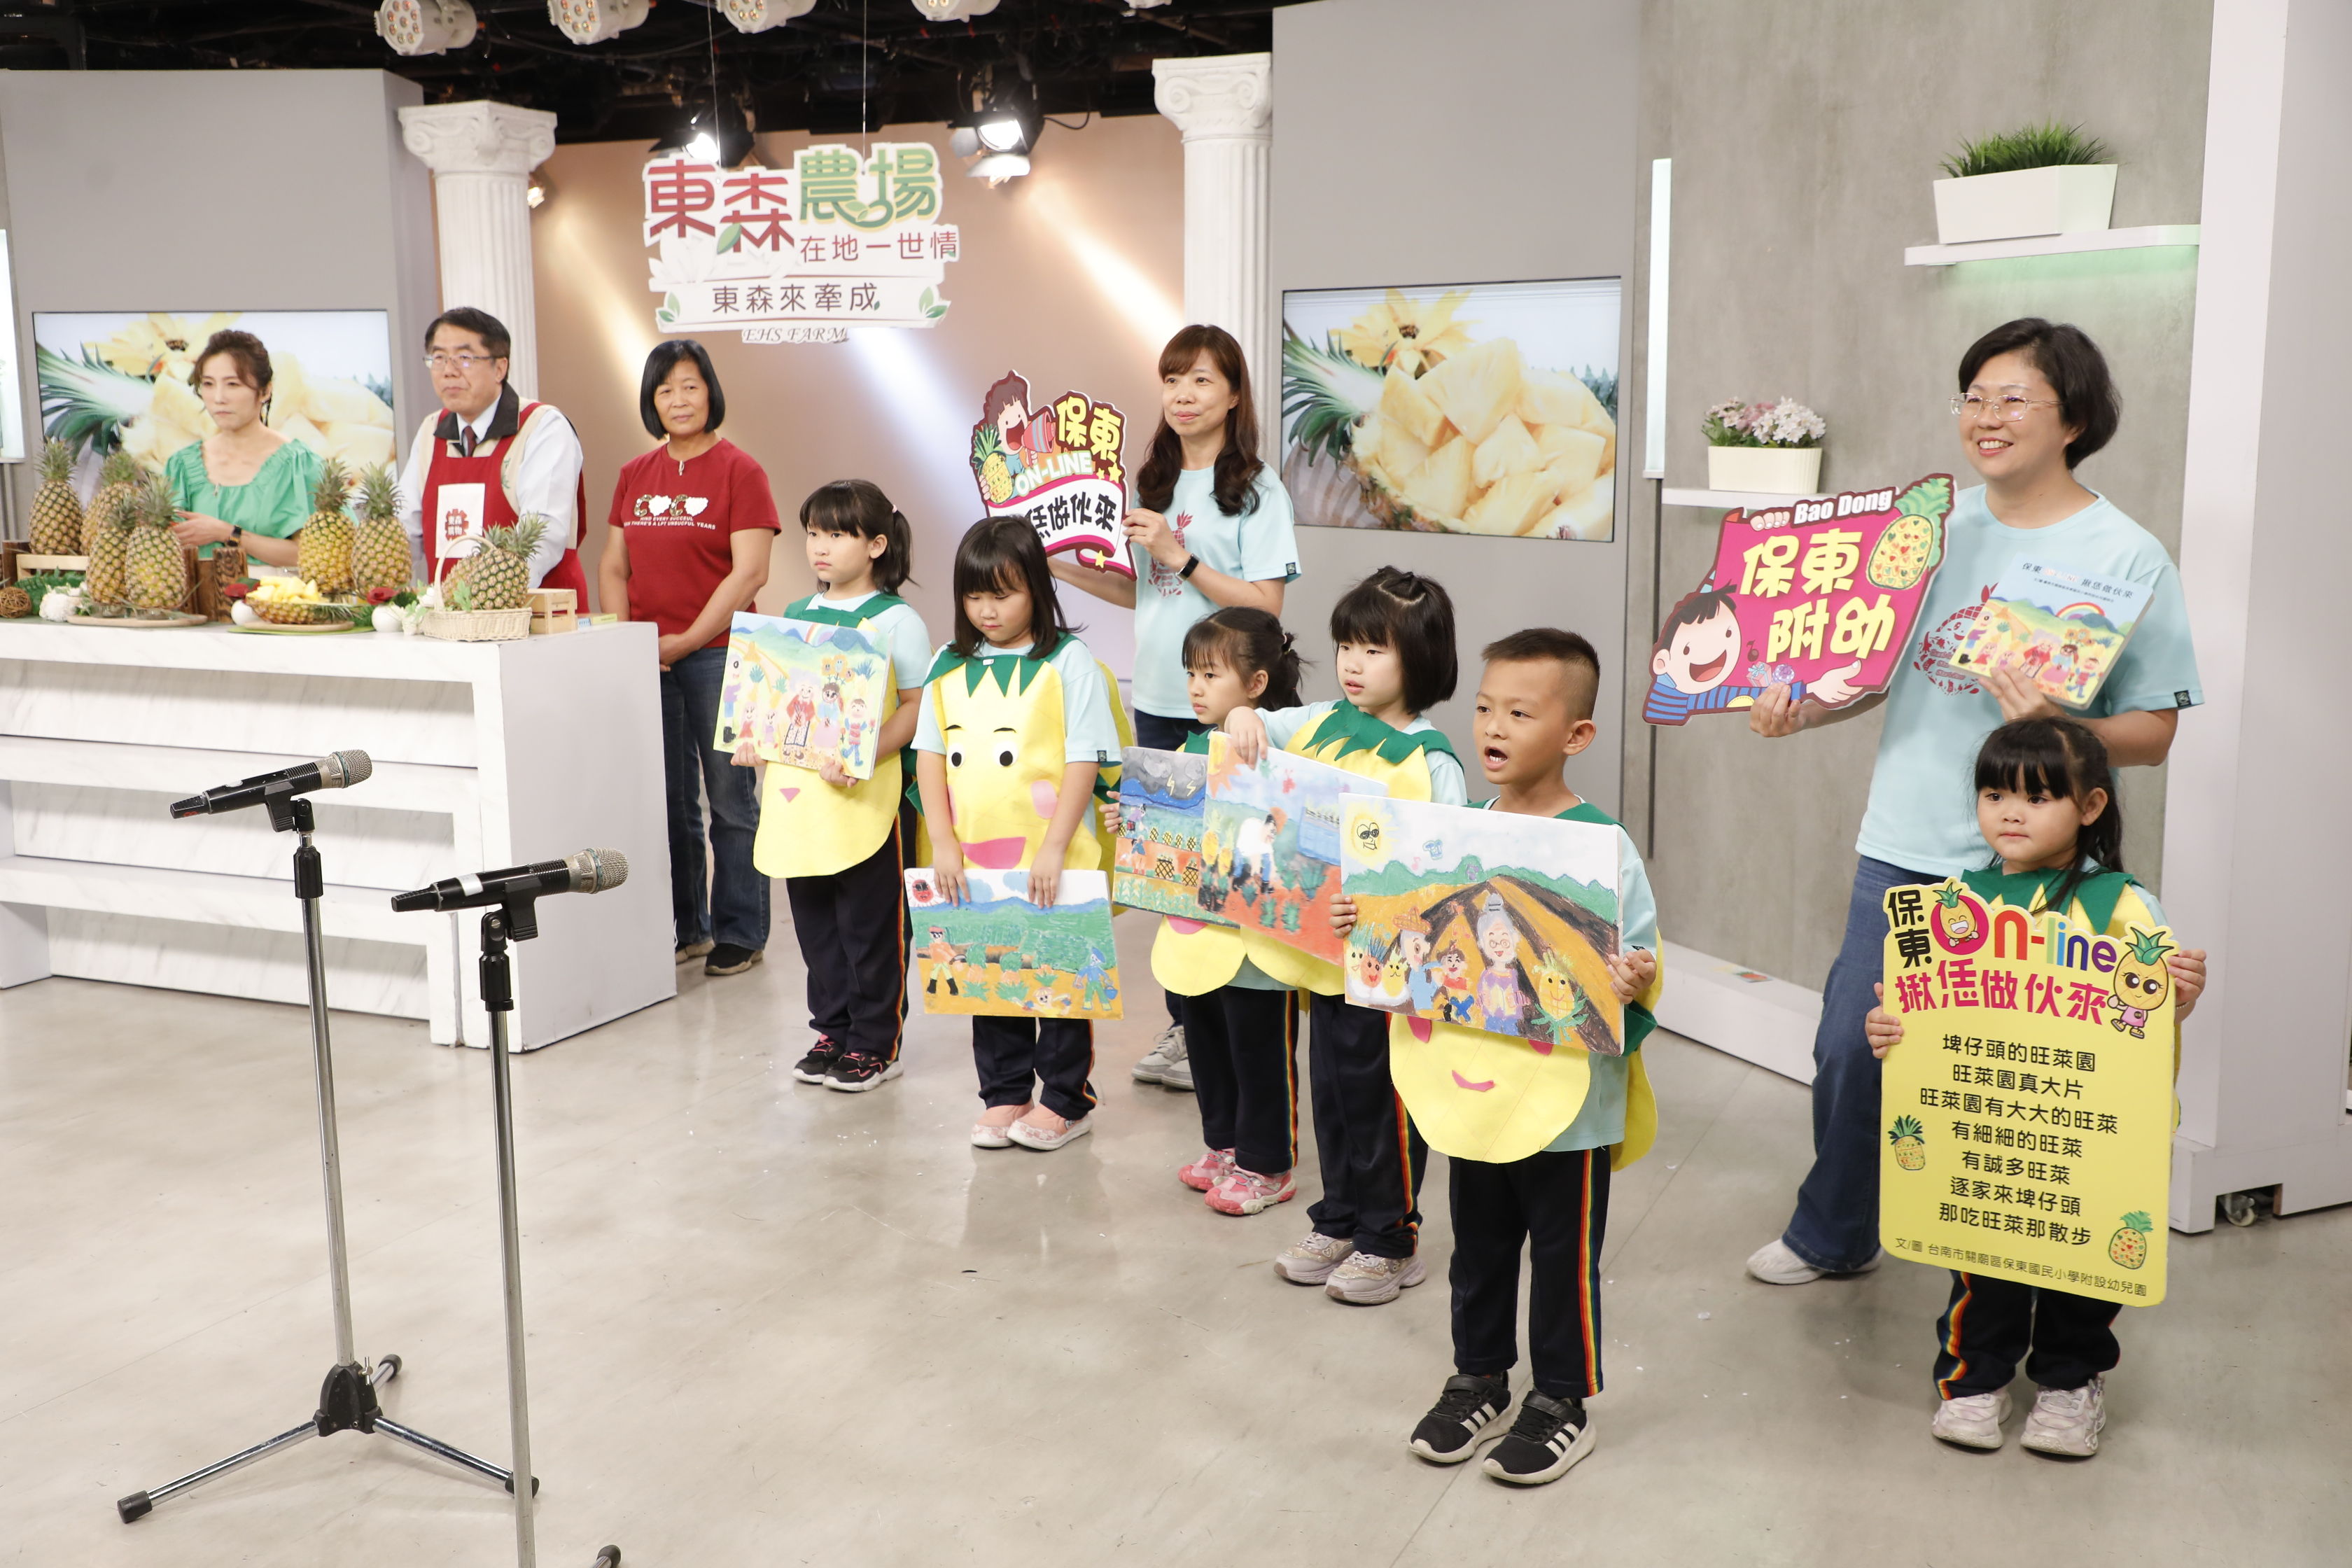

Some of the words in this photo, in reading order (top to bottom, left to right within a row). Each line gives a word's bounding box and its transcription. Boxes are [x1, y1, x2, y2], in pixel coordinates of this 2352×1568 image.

[648, 148, 937, 253] 東森農場
[800, 231, 958, 263] 在地一世情
[713, 282, 878, 314] 東森來牽成
[743, 328, 782, 342] EHS
[788, 327, 846, 342] FARM
[1056, 396, 1121, 463] 保東
[1016, 451, 1093, 496] ON-LINE
[696, 522, 716, 531] YEARS
[1793, 501, 1834, 524] Bao
[1837, 490, 1893, 517] Dong
[1740, 528, 1863, 598] 保東
[1766, 594, 1896, 663] 附幼
[1888, 889, 1932, 968] 保東
[1895, 958, 2110, 1025] 揪恁做伙來
[1942, 1034, 2095, 1072] 埤仔頭的旺萊園
[1953, 1064, 2083, 1100] 旺萊園真大片
[1920, 1088, 2118, 1134] 旺萊園有大大的旺萊
[1952, 1121, 2082, 1158] 有細細的旺萊
[1961, 1150, 2071, 1185] 有誠多旺萊
[1950, 1176, 2081, 1217] 逐家來埤仔頭
[1939, 1203, 2091, 1245] 那吃旺萊那散步
[1895, 1238, 1923, 1252] 文/圖
[1928, 1243, 2147, 1296] 台南市關廟區保東國民小學附設幼兒園
